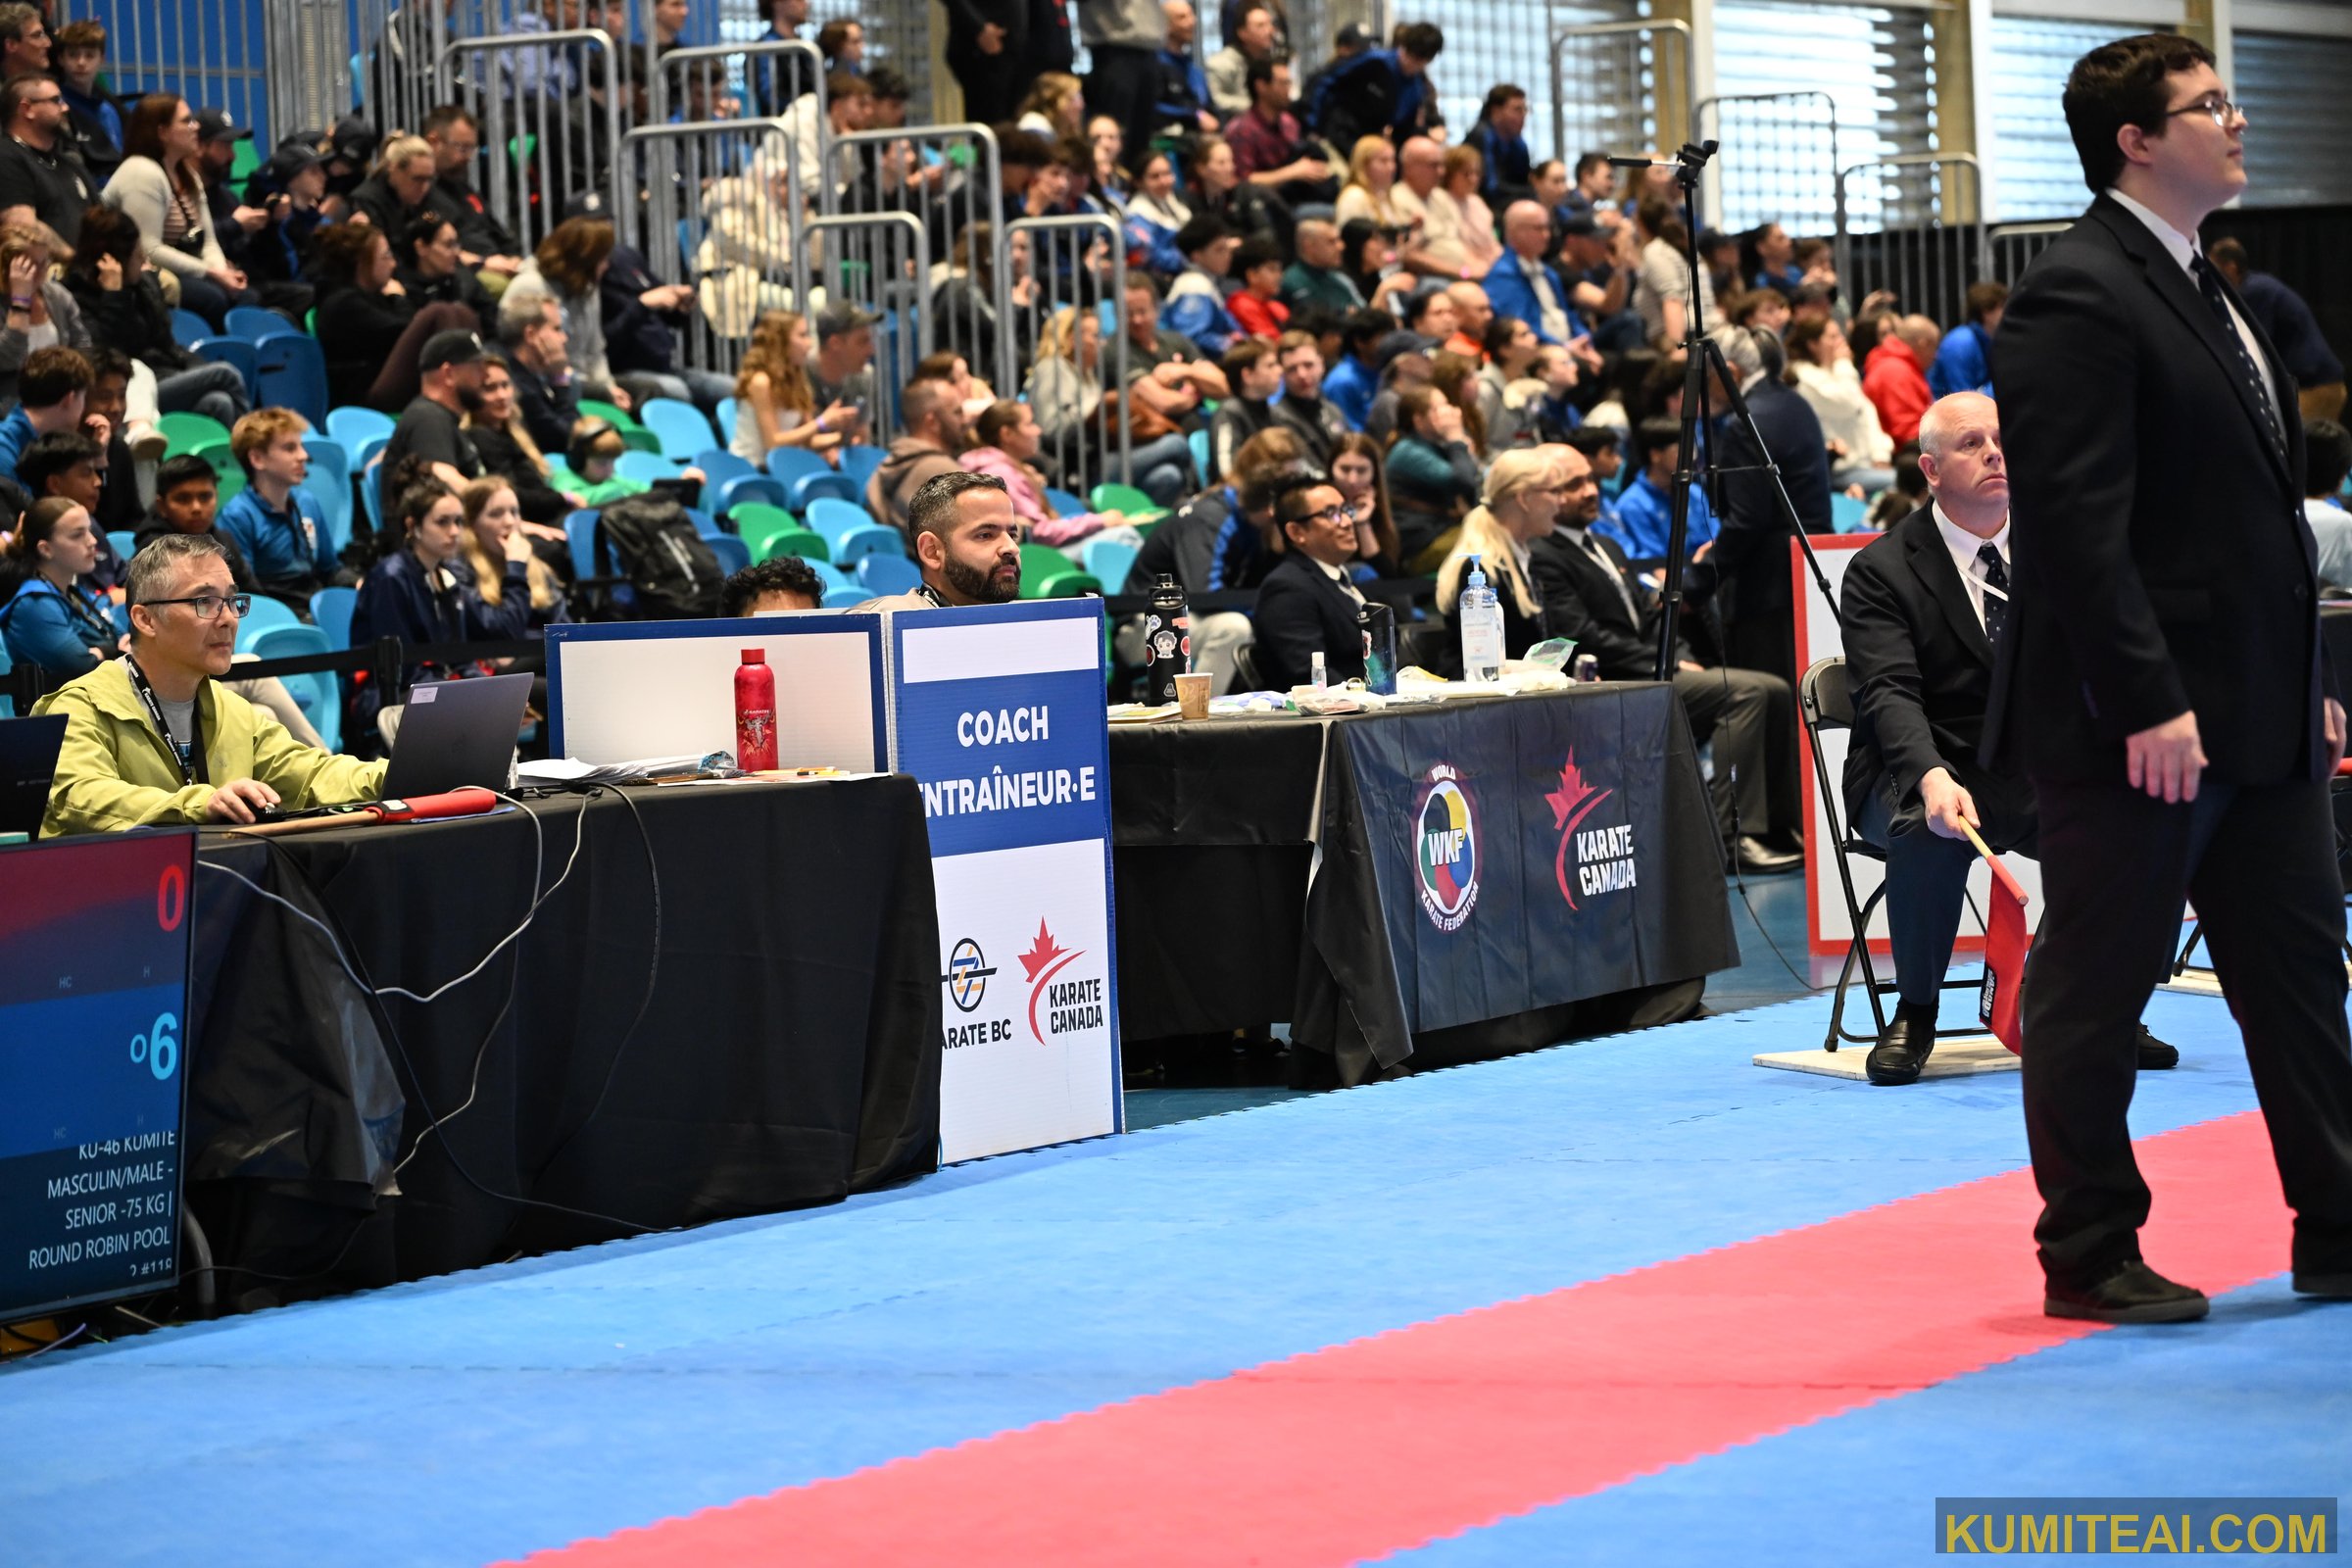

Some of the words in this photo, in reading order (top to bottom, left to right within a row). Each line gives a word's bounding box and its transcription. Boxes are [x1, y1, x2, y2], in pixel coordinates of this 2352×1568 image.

[956, 706, 1049, 748] COACH
[917, 764, 1096, 818] NTRAÎNEUR·E
[1431, 764, 1456, 782] WORLD
[1427, 828, 1463, 867] WKF
[1576, 824, 1634, 862] KARATE
[1579, 858, 1637, 896] CANADA
[157, 864, 185, 932] 0
[1421, 889, 1443, 931] KARATE
[1444, 881, 1479, 931] FEDERATION
[1050, 978, 1101, 1007] KARATE
[991, 1018, 1011, 1042] BC
[1051, 1004, 1103, 1034] CANADA
[48, 1160, 165, 1199] MASCULIN/MALE
[65, 1202, 117, 1229] SENIOR
[121, 1198, 142, 1218] -75
[146, 1193, 165, 1215] KG
[29, 1242, 82, 1269] ROUND
[85, 1233, 129, 1259] ROBIN
[133, 1226, 171, 1250] POOL
